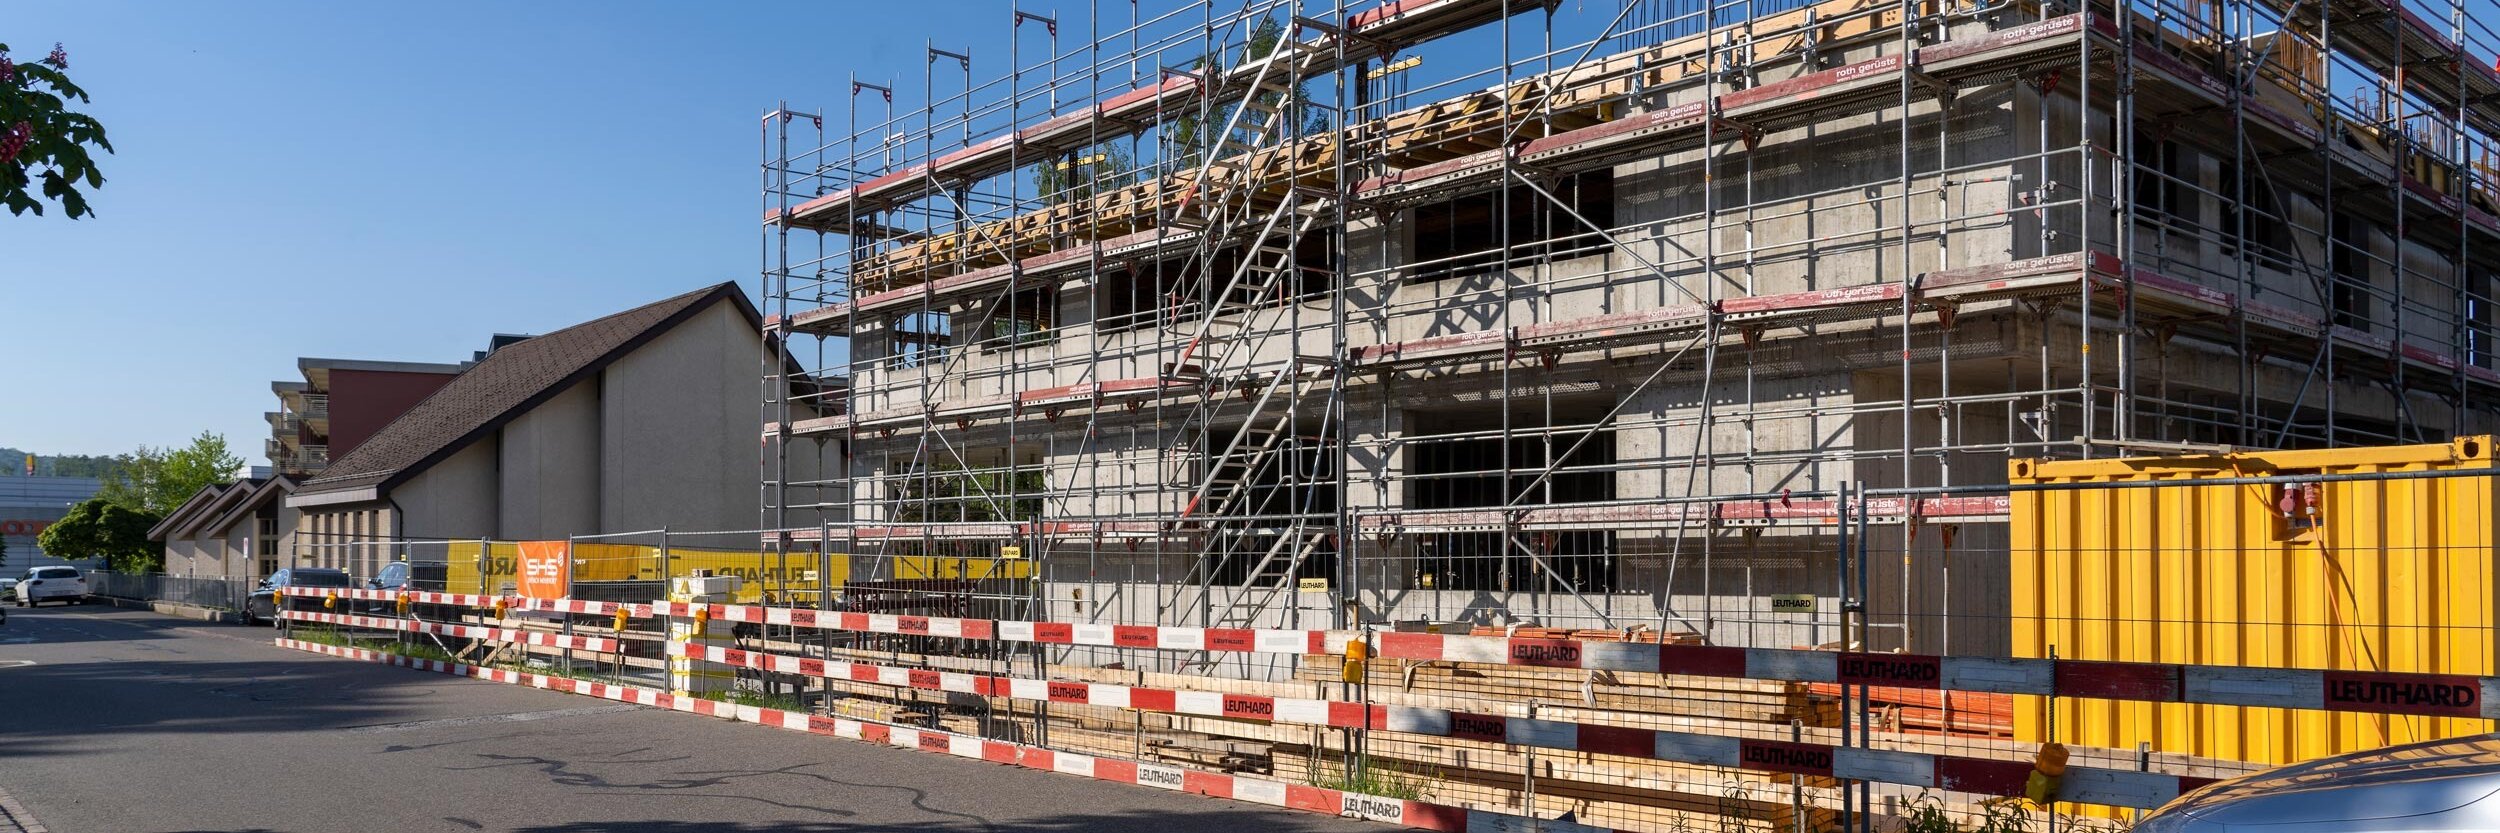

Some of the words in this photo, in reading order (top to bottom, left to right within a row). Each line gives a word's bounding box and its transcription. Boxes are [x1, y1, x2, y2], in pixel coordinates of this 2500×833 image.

[2003, 27, 2026, 40] roth
[2029, 18, 2074, 36] gerüste
[1836, 66, 1856, 78] roth
[1858, 57, 1897, 75] gerüste
[1651, 110, 1668, 120] roth
[1670, 102, 1703, 118] gerüste
[2004, 259, 2027, 271] roth
[2030, 253, 2075, 269] gerüste
[526, 558, 558, 576] SHS
[1772, 598, 1811, 609] LEUTHARD
[898, 619, 928, 631] LEUTHARD
[1512, 644, 1580, 662] LEUTHARD
[909, 672, 940, 685] LEUTHARD
[1841, 659, 1938, 682] LEUTHARD
[1049, 686, 1088, 700] LEUTHARD
[2331, 681, 2475, 707] LEUTHARD
[1225, 699, 1273, 715] LEUTHARD
[1453, 718, 1504, 736] UTHARD
[920, 734, 949, 749] LEUTHARD
[1744, 745, 1831, 770] LEUTHARD
[1139, 768, 1183, 786] LEUTHARD
[1344, 797, 1401, 818] LEUTHARD
